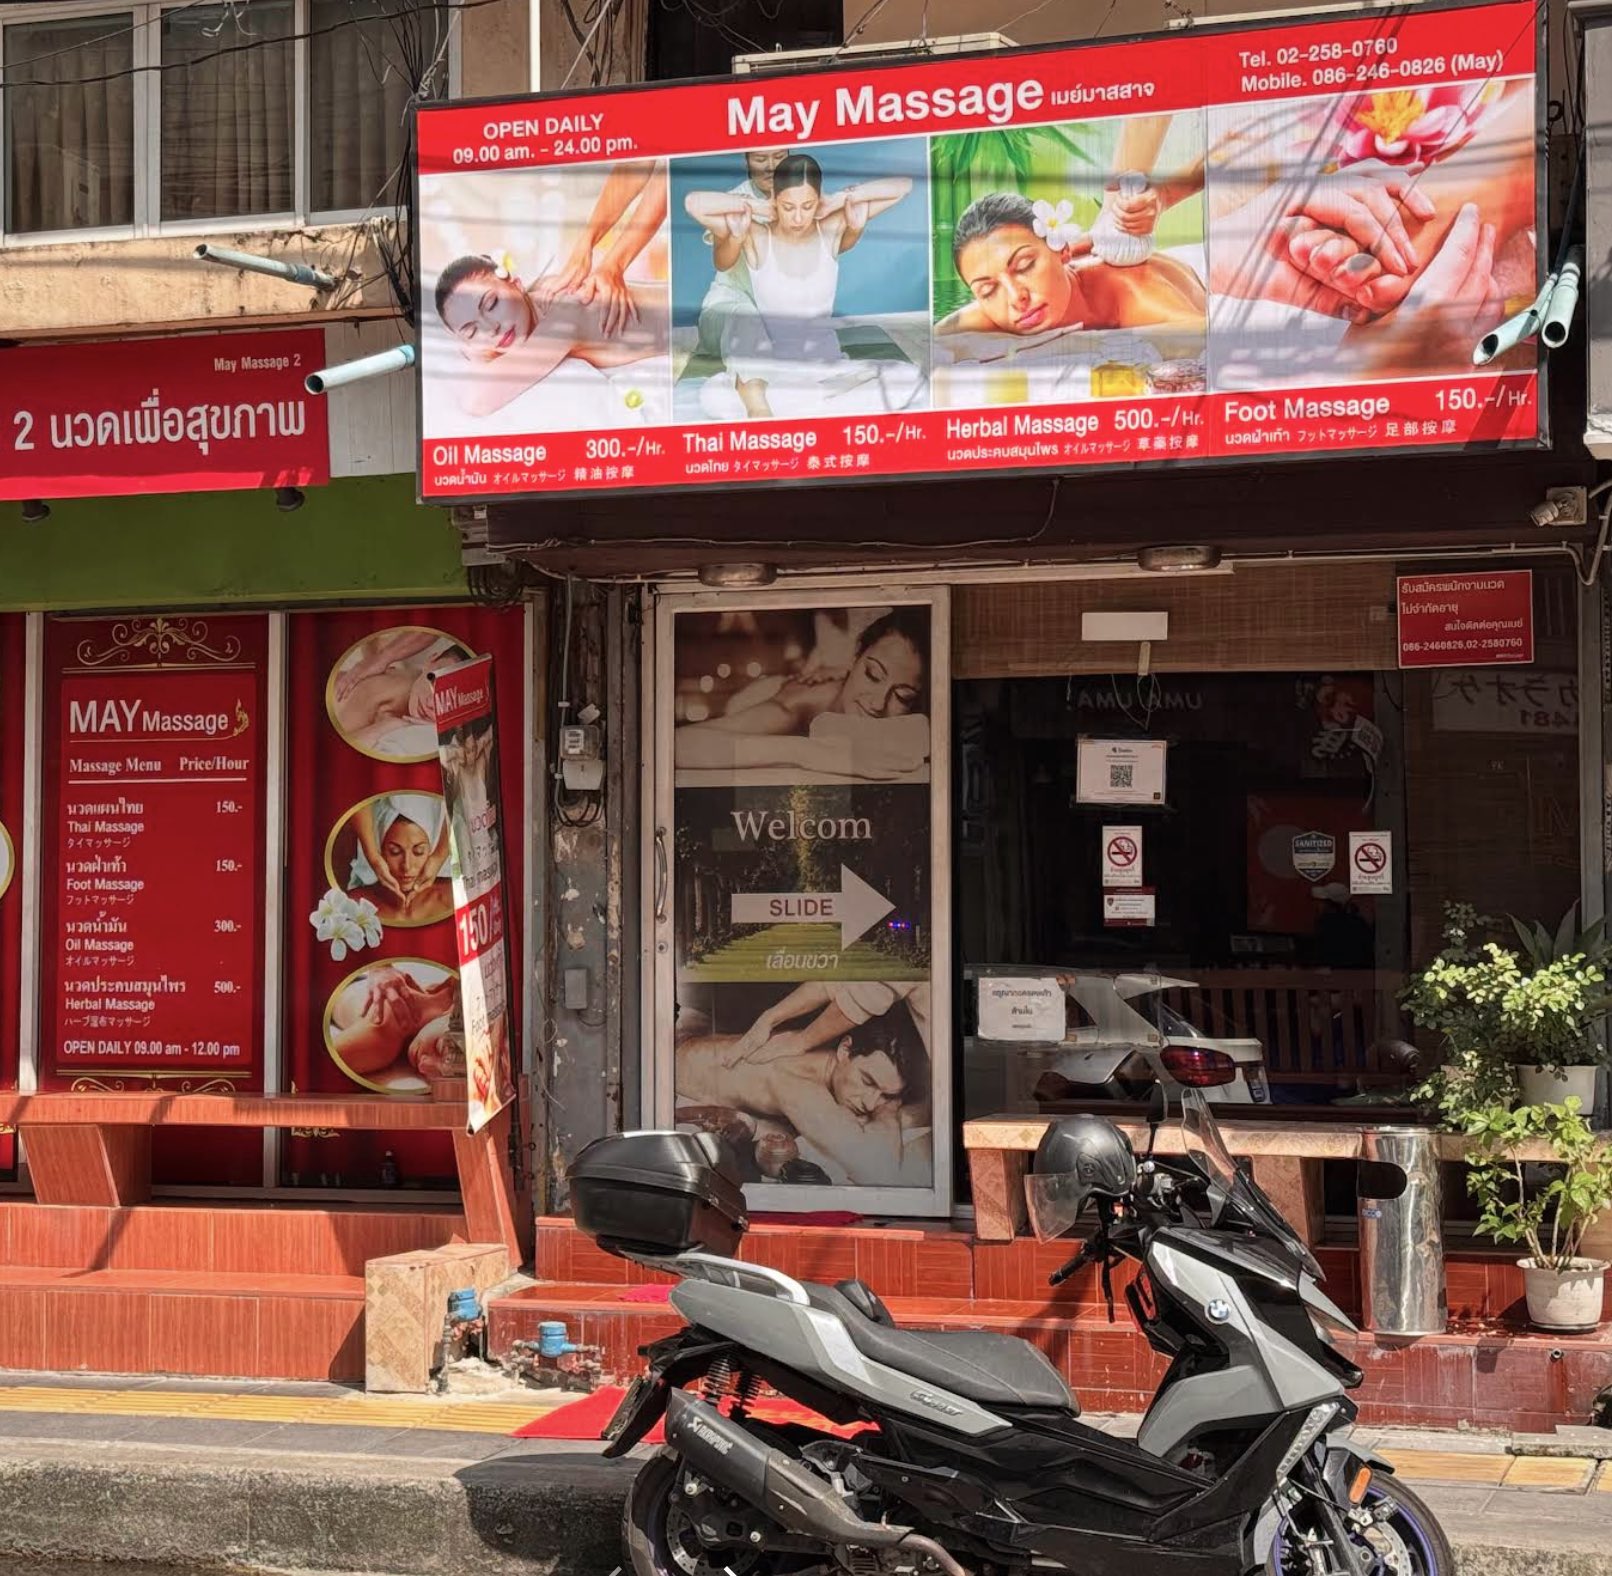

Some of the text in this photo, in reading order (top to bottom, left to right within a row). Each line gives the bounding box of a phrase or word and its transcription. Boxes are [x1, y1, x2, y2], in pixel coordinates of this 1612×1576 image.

[1239, 37, 1398, 69] Tel. 02-258-0760
[1241, 49, 1504, 93] Mobile. 086-246-0826 (May)
[727, 79, 1156, 140] May Massage เมย์มาสสาจ
[483, 113, 604, 140] OPEN DAILY
[452, 145, 501, 165] 09.00
[504, 145, 535, 161] am.
[553, 137, 602, 157] 24.00
[605, 135, 639, 156] pm.
[214, 354, 302, 373] May Massage 2
[1224, 399, 1277, 423] Foot
[1283, 396, 1391, 420] Massage
[13, 388, 306, 456] 2 นวดเพื่อสุขภาพ
[946, 416, 1008, 439] Herbal
[1014, 414, 1100, 438] Massage
[1297, 424, 1378, 443] フットマッサージ
[1386, 419, 1458, 437] 足部按摩
[682, 432, 724, 453] Thai
[729, 430, 817, 453] Massage
[433, 445, 459, 465] Oil
[464, 444, 547, 466] Massage
[685, 453, 871, 474] นวดไทย タイマッサージ 泰式按摩
[493, 468, 566, 484] オイルマッサージ
[435, 685, 458, 716] MAY
[69, 699, 229, 735] MAY Massage
[69, 756, 250, 776] Massage Menu Price/Hour
[67, 797, 144, 816] นวดแผนไทย
[216, 801, 243, 814] 150.-
[67, 821, 145, 835] Thai Massage
[730, 809, 873, 842] Welcom
[67, 836, 131, 849] タイマッサージ
[66, 855, 127, 873] นวดฝ่าเท้า
[215, 859, 243, 872] 150.-
[66, 878, 145, 893] Foot Massage
[769, 898, 834, 917] SLIDE
[66, 911, 127, 934] นวดน้ำมัน
[214, 919, 242, 933] 300.-
[65, 938, 134, 953] Oil Massage
[64, 974, 186, 998] นวดประคบสมุนไพร
[214, 980, 241, 994] 500.-
[65, 998, 155, 1013] Herbal Massage
[63, 1040, 95, 1055] OPEN
[98, 1040, 131, 1055] DAILY
[134, 1041, 163, 1055] 09.00
[165, 1044, 181, 1055] am
[191, 1041, 220, 1056] 12.00
[223, 1044, 241, 1059] pm
